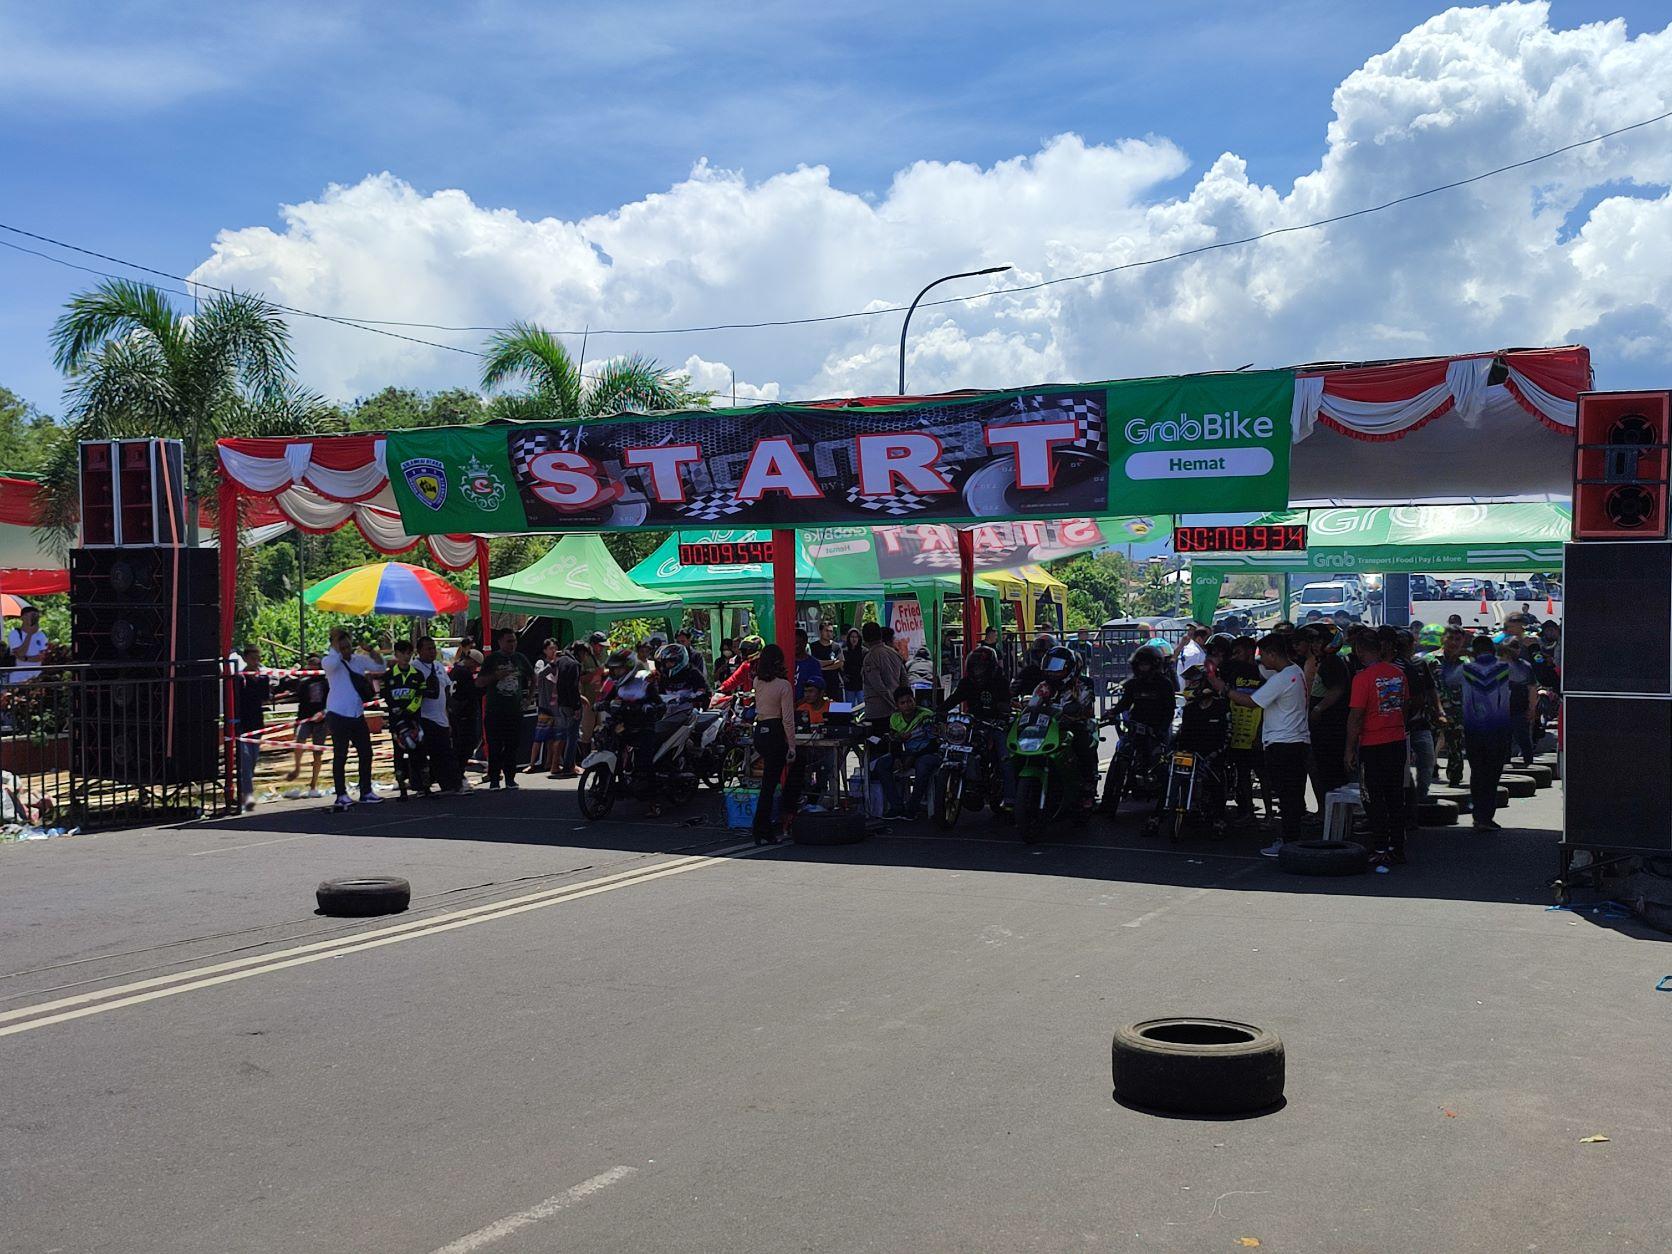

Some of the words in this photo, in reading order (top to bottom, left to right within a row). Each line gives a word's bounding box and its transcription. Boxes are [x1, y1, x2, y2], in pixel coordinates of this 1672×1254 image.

[1125, 411, 1273, 444] GrabBike
[530, 420, 1079, 506] START
[1169, 457, 1226, 472] Hemat
[1313, 551, 1355, 567] Grab
[1358, 557, 1392, 565] Transport
[1418, 556, 1431, 565] Pay
[1443, 555, 1462, 563] More
[1195, 576, 1218, 585] Grab
[898, 603, 921, 618] Fried
